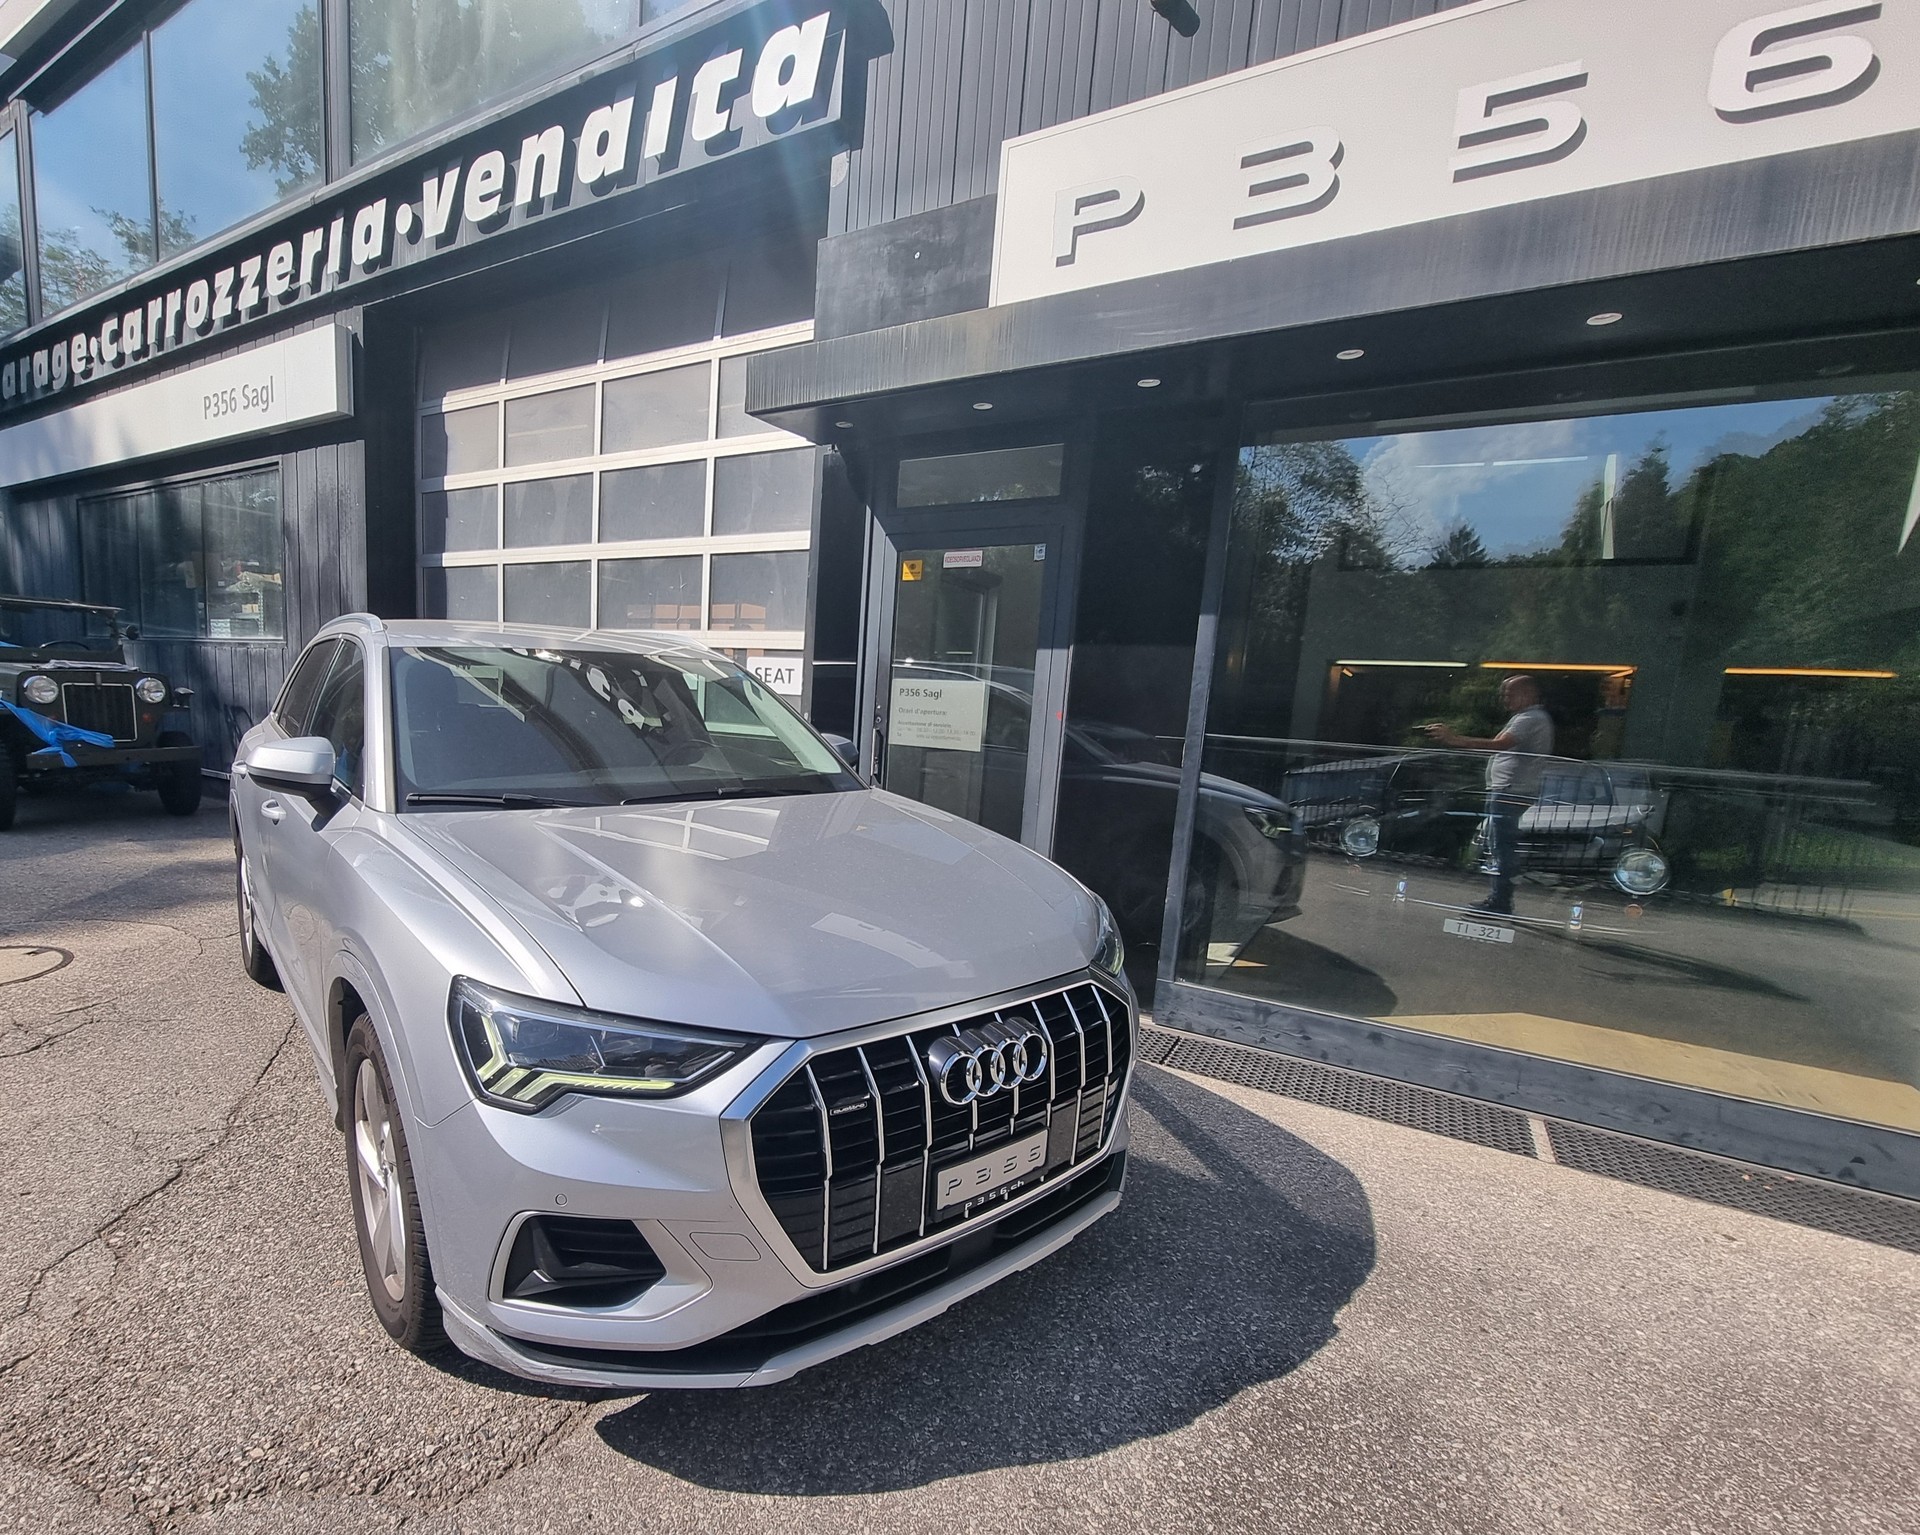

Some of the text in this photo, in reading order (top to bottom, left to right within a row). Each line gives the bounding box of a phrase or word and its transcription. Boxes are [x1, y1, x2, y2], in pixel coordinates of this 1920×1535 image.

[203, 375, 274, 420] P356 Sagl
[754, 666, 796, 684] SEAT
[899, 687, 943, 701] P356 Sagl
